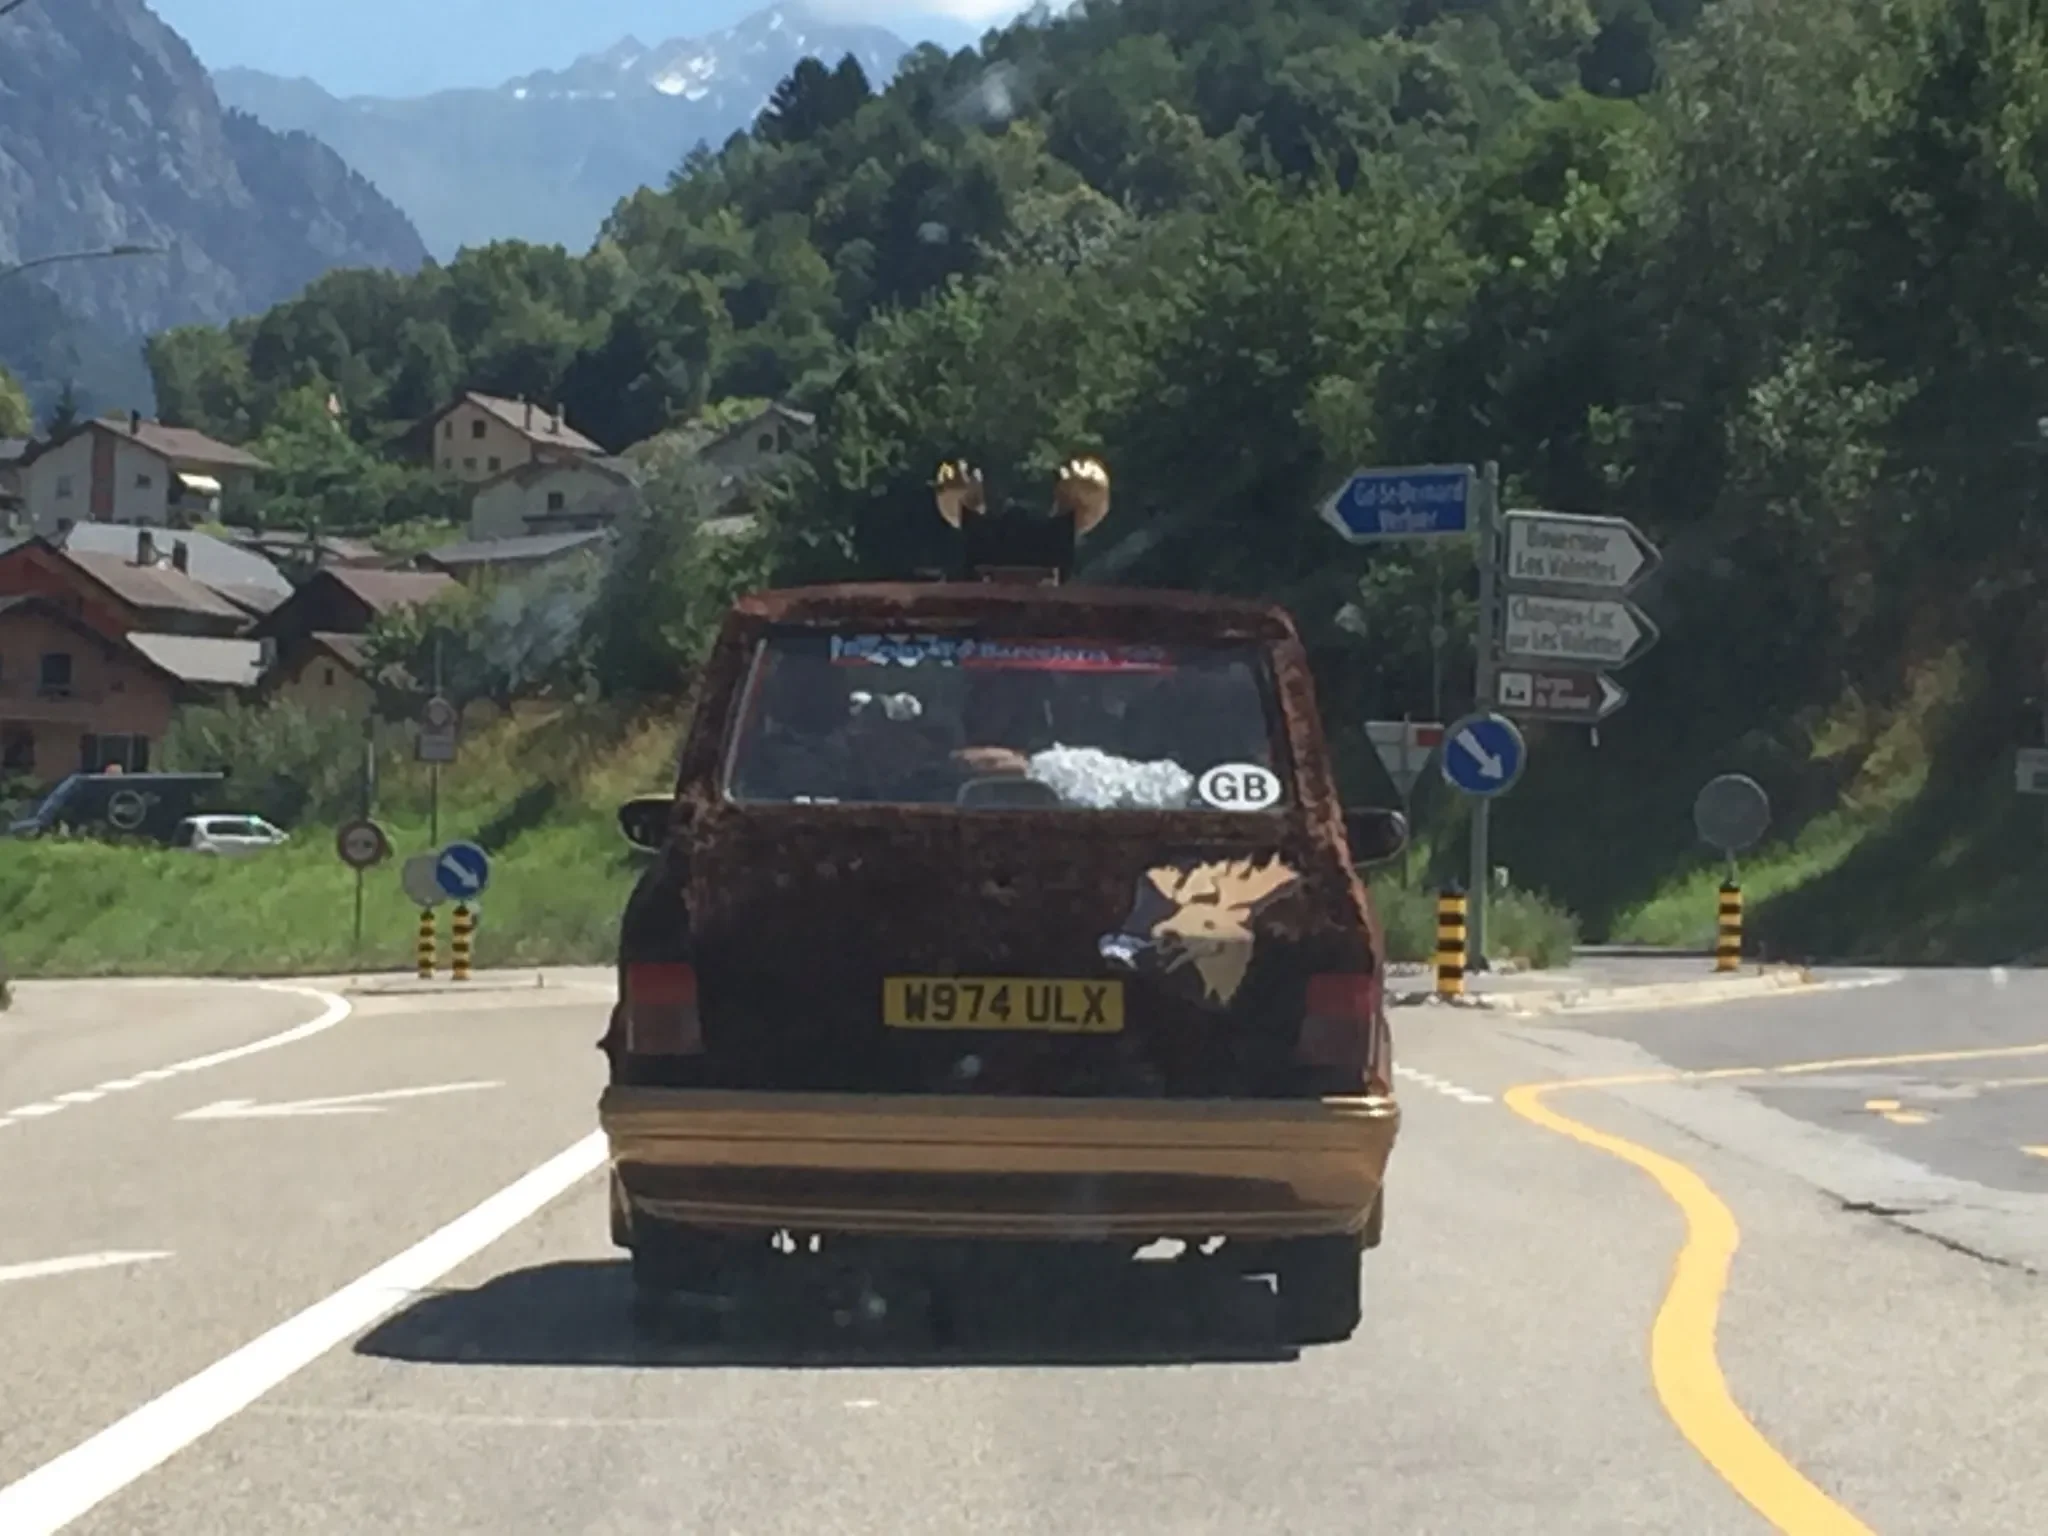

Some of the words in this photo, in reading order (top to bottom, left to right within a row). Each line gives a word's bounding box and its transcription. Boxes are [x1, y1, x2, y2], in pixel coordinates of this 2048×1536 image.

[1210, 771, 1268, 803] GB
[904, 982, 1012, 1022] W974
[1025, 984, 1107, 1025] ULX
